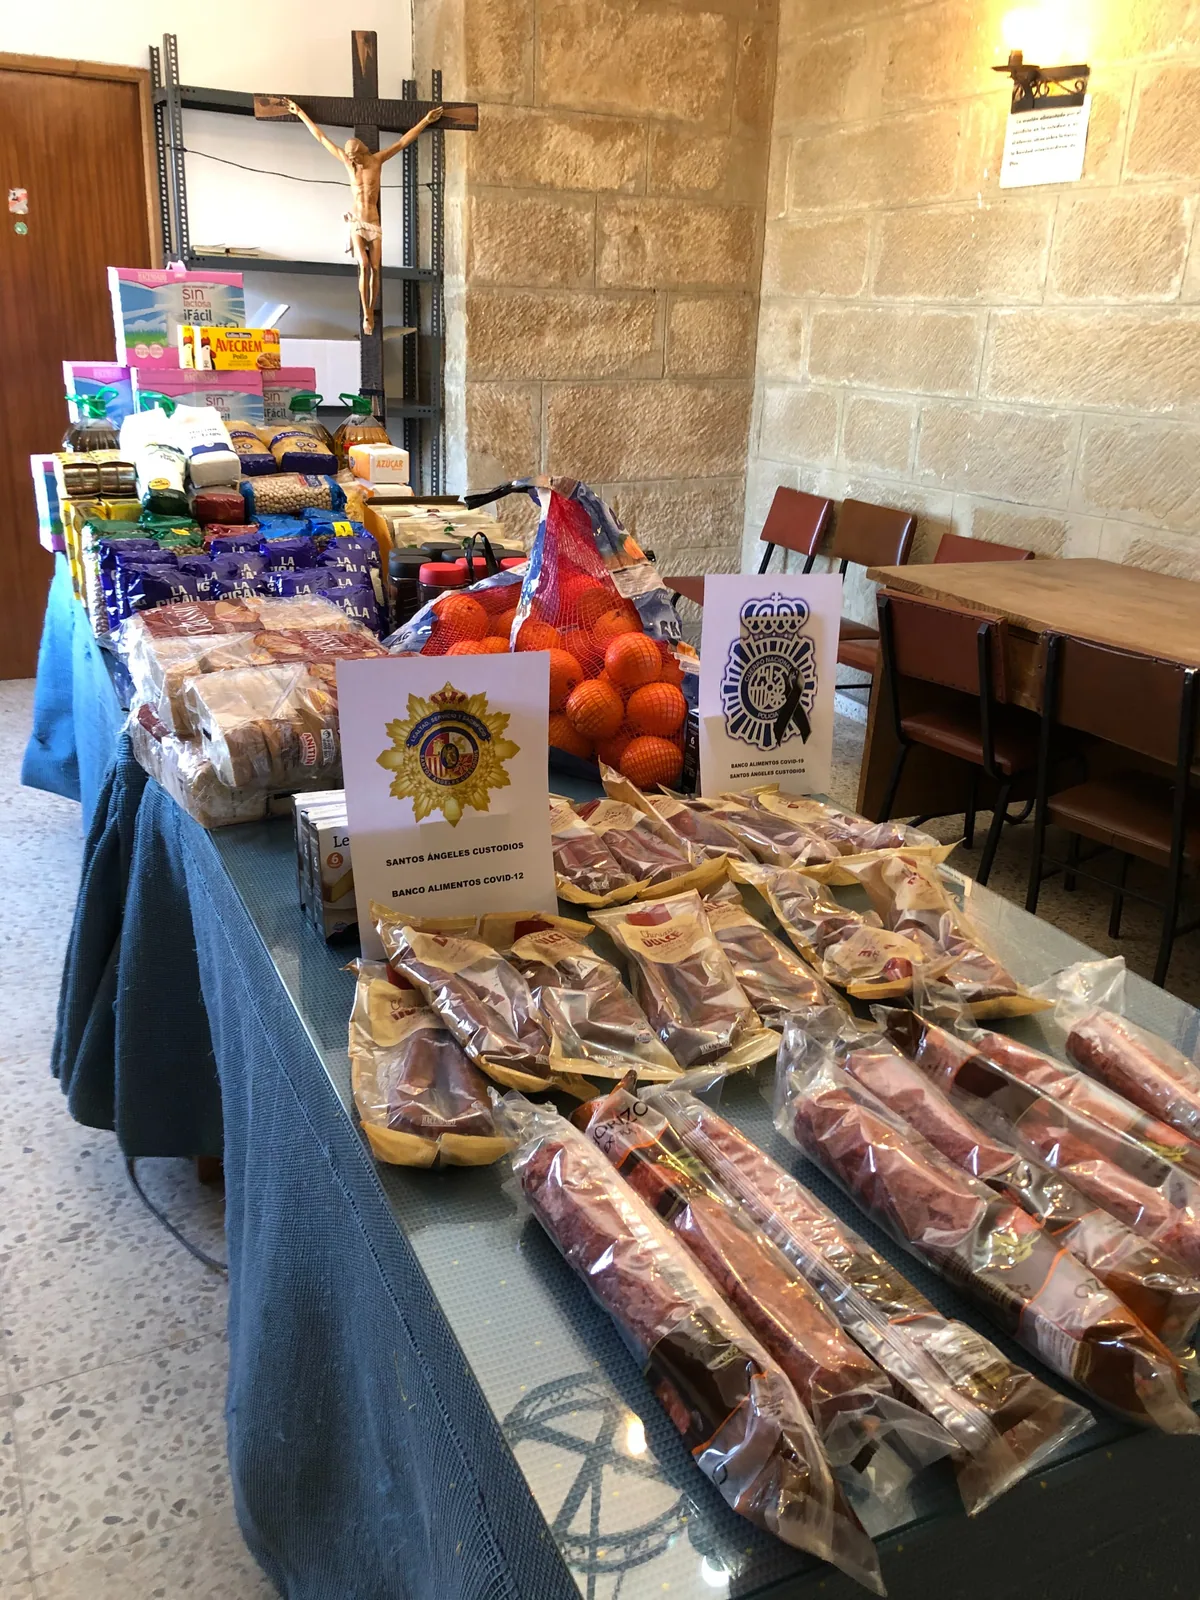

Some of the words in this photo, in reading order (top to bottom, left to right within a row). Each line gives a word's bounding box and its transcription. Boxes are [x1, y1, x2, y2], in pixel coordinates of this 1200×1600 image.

[182, 288, 204, 300] sin
[215, 337, 263, 352] AVECREM
[205, 396, 225, 406] sin
[281, 556, 295, 566] LA
[233, 581, 250, 590] LA
[338, 578, 352, 586] LA
[170, 585, 187, 596] LA
[296, 584, 312, 595] LA
[302, 732, 316, 765] ANITIN
[385, 854, 425, 867] SANTOS
[427, 849, 470, 862] ÁNGELES
[472, 842, 524, 855] CUSTODIOS
[391, 886, 426, 898] BANCO
[427, 878, 481, 893] ALIMENTOS
[483, 872, 524, 885] COVID-12
